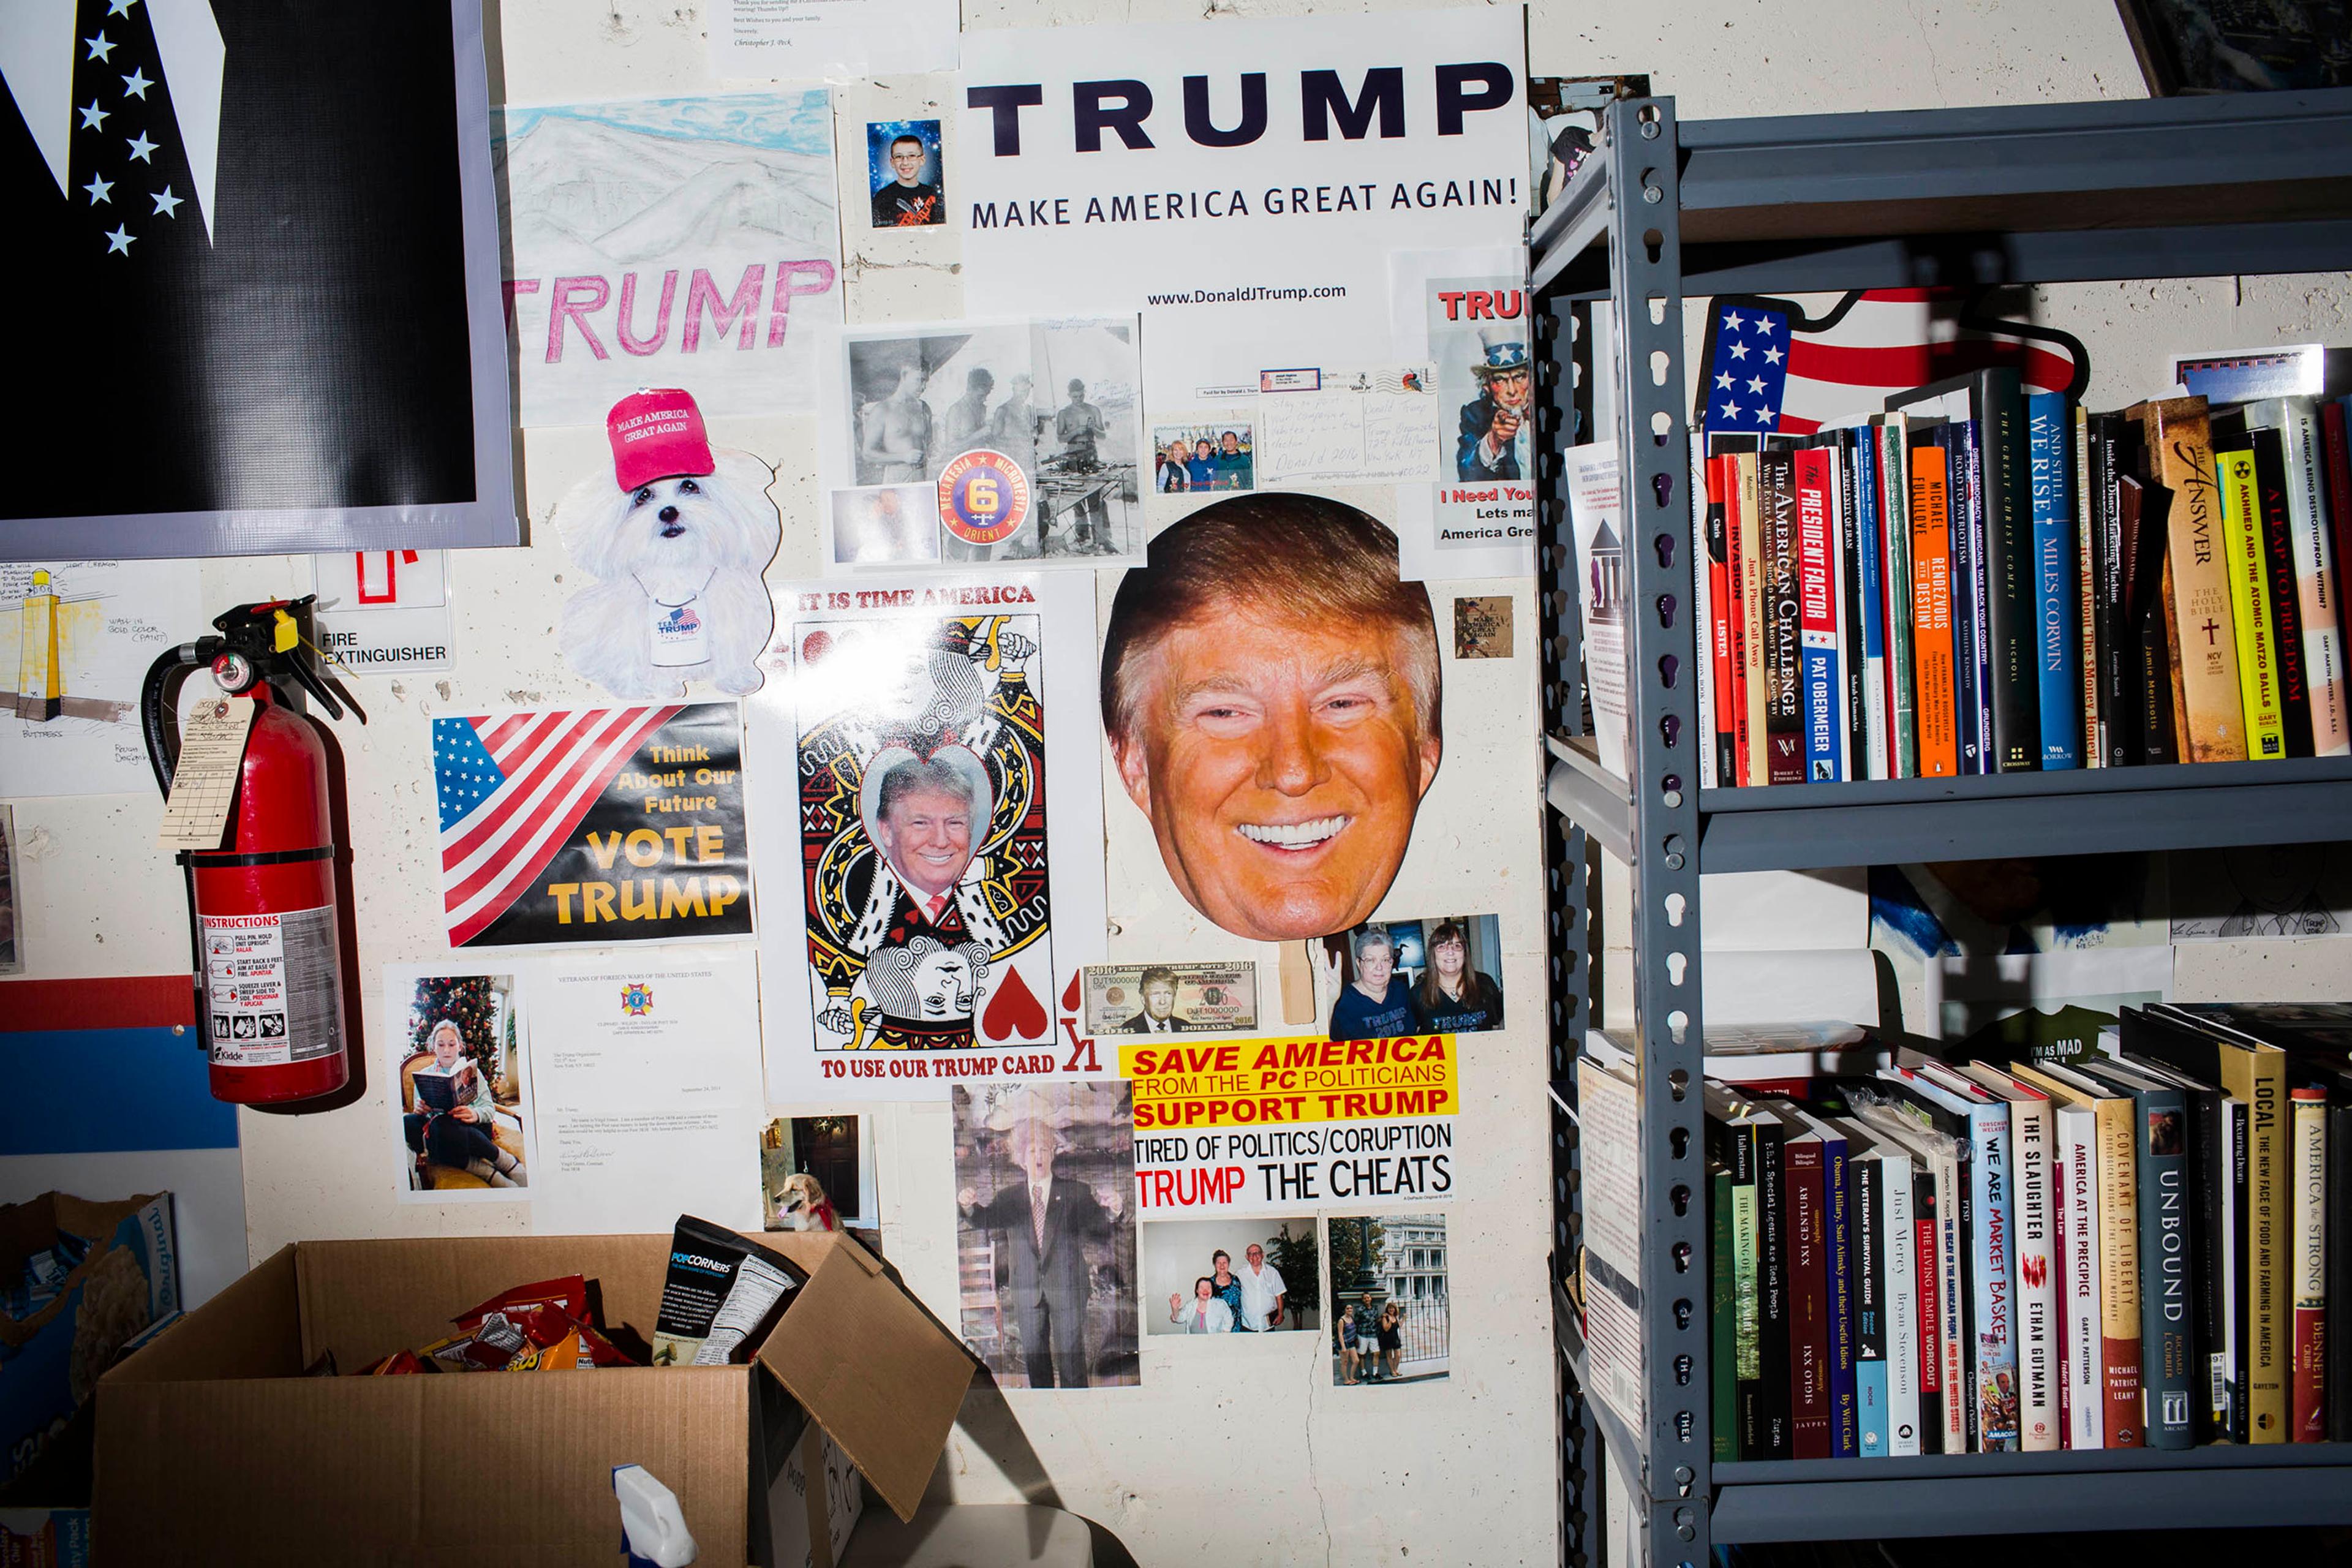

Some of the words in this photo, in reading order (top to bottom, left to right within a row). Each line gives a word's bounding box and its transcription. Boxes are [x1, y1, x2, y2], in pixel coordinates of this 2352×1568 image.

[734, 39, 769, 48] Christopher
[967, 62, 1514, 157] TRUMP
[971, 198, 1071, 229] MAKE
[1084, 189, 1249, 224] AMERICA
[1264, 183, 1378, 216] GREAT
[1390, 178, 1518, 209] AGAIN!
[1148, 284, 1346, 307] www.DonaldJTrump.com
[1438, 290, 1531, 321] TRU
[616, 417, 643, 433] MAKE
[644, 409, 689, 423] AMERICA
[624, 428, 656, 443] GREAT
[657, 421, 687, 434] AGAIN
[2030, 414, 2048, 451] WE
[2051, 423, 2062, 456] AND
[940, 459, 973, 511] MELANESIA
[993, 460, 1024, 513] MICRONESIA
[1776, 462, 1789, 489] THE
[1806, 465, 1819, 485] The
[2032, 458, 2051, 513] RISE
[2052, 459, 2063, 502] STILL
[964, 478, 999, 514] 6
[1441, 490, 1446, 503] I
[1452, 488, 1498, 502] Need
[1477, 508, 1508, 518] Lets
[1913, 478, 1927, 535] FULLILOVE
[1930, 482, 1943, 530] MICHAEL
[2173, 442, 2218, 567] ANSWER
[2240, 484, 2253, 532] AKHMED
[963, 528, 1000, 541] ORIENT
[1441, 528, 1502, 540] America
[1775, 493, 1794, 595] AMERICAN
[1801, 488, 1825, 568] PRESIDENT
[2245, 535, 2256, 559] AND
[1732, 526, 1741, 600] INVASION
[2043, 538, 2059, 594] MILES
[2246, 561, 2258, 582] THE
[797, 593, 821, 611] IT
[827, 591, 851, 610] IS
[856, 589, 915, 609] TIME
[922, 585, 1036, 607] AMERICA
[1804, 567, 1827, 619] FACTOR
[1917, 583, 1932, 630] DESTINY
[1932, 557, 1947, 629] RENDEZVOUS
[2191, 605, 2225, 616] BIBLE
[2192, 596, 2223, 606] HOLY
[2195, 587, 2218, 597] THE
[2251, 586, 2263, 628] ATOMIC
[132, 633, 168, 643] (PAINT)
[322, 633, 358, 647] FIRE
[658, 622, 697, 634] TRUMP
[1717, 619, 1727, 657] LISTEN
[2045, 598, 2062, 672] CORWIN
[323, 646, 447, 665] EXTINGUISHER
[1735, 630, 1745, 680] ALERT
[1779, 600, 1798, 716] CHALLENGE
[1811, 657, 1826, 679] PAT
[2255, 631, 2267, 669] MATZO
[2260, 673, 2271, 708] BALLS
[1812, 683, 1830, 752] OBERMEIER
[650, 744, 710, 763] Think
[617, 769, 686, 790] About
[696, 768, 736, 785] Our
[645, 795, 717, 813] Future
[586, 825, 725, 870] VOTE
[548, 875, 742, 924] TRUMP
[204, 916, 279, 928] INSTRUCTIONS
[1088, 966, 1117, 976] 2016
[1224, 961, 1253, 971] 2016
[221, 1050, 243, 1060] Kidde
[1060, 1018, 1102, 1072] K
[1132, 1046, 1240, 1076] SAVE
[1252, 1036, 1446, 1070] AMERICA
[2030, 1046, 2043, 1057] I'M
[2045, 1046, 2055, 1056] AS
[2057, 1039, 2082, 1055] MAD
[821, 1059, 846, 1078] TO
[850, 1058, 886, 1077] USE
[891, 1058, 929, 1077] OUR
[932, 1057, 998, 1077] TRUMP
[1002, 1054, 1055, 1074] CARD
[1133, 1078, 1198, 1096] FROM
[1205, 1074, 1250, 1093] THE
[1259, 1071, 1297, 1090] PC
[1304, 1065, 1446, 1089] POLITICIANS
[1133, 1097, 1306, 1128] SUPPORT
[1319, 1089, 1449, 1118] TRUMP
[2255, 1078, 2274, 1133] LOCAL
[1134, 1137, 1188, 1164] TIRED
[1196, 1135, 1221, 1159] OF
[1229, 1123, 1452, 1159] POLITICS/CORUPTION
[2024, 1115, 2040, 1143] THE
[1986, 1137, 2000, 1166] WE
[2075, 1144, 2087, 1195] AMERICA
[2117, 1133, 2131, 1207] COVENANT
[2309, 1125, 2322, 1205] AMERICA
[1136, 1166, 1245, 1208] TRUMP
[1258, 1162, 1319, 1201] THE
[1329, 1155, 1452, 1198] CHEATS
[1988, 1171, 2002, 1203] ARE
[2026, 1152, 2043, 1240] SLAUGHTER
[1861, 1187, 1870, 1232] VETERAN'S
[1894, 1189, 1905, 1220] Just
[2076, 1199, 2087, 1212] AT
[1989, 1208, 2005, 1275] MARKET
[2077, 1216, 2088, 1237] THE
[2119, 1218, 2132, 1234] OF
[671, 1252, 731, 1273] POPCORNERS
[1862, 1234, 1871, 1276] SURVIVAL
[1893, 1229, 1907, 1276] Mercy
[2160, 1170, 2183, 1321] UNBOUND
[2309, 1224, 2321, 1291] STRONG
[2078, 1241, 2090, 1297] PRECIPICE
[2120, 1244, 2133, 1305] LIBERTY
[1896, 1292, 1907, 1327] Bryan
[1989, 1280, 2007, 1345] BASKET
[2030, 1303, 2043, 1341] ETHAN
[1898, 1332, 1908, 1395] Stevenson
[2313, 1322, 2324, 1391] BENNETT
[2031, 1348, 2045, 1408] GUTMANN
